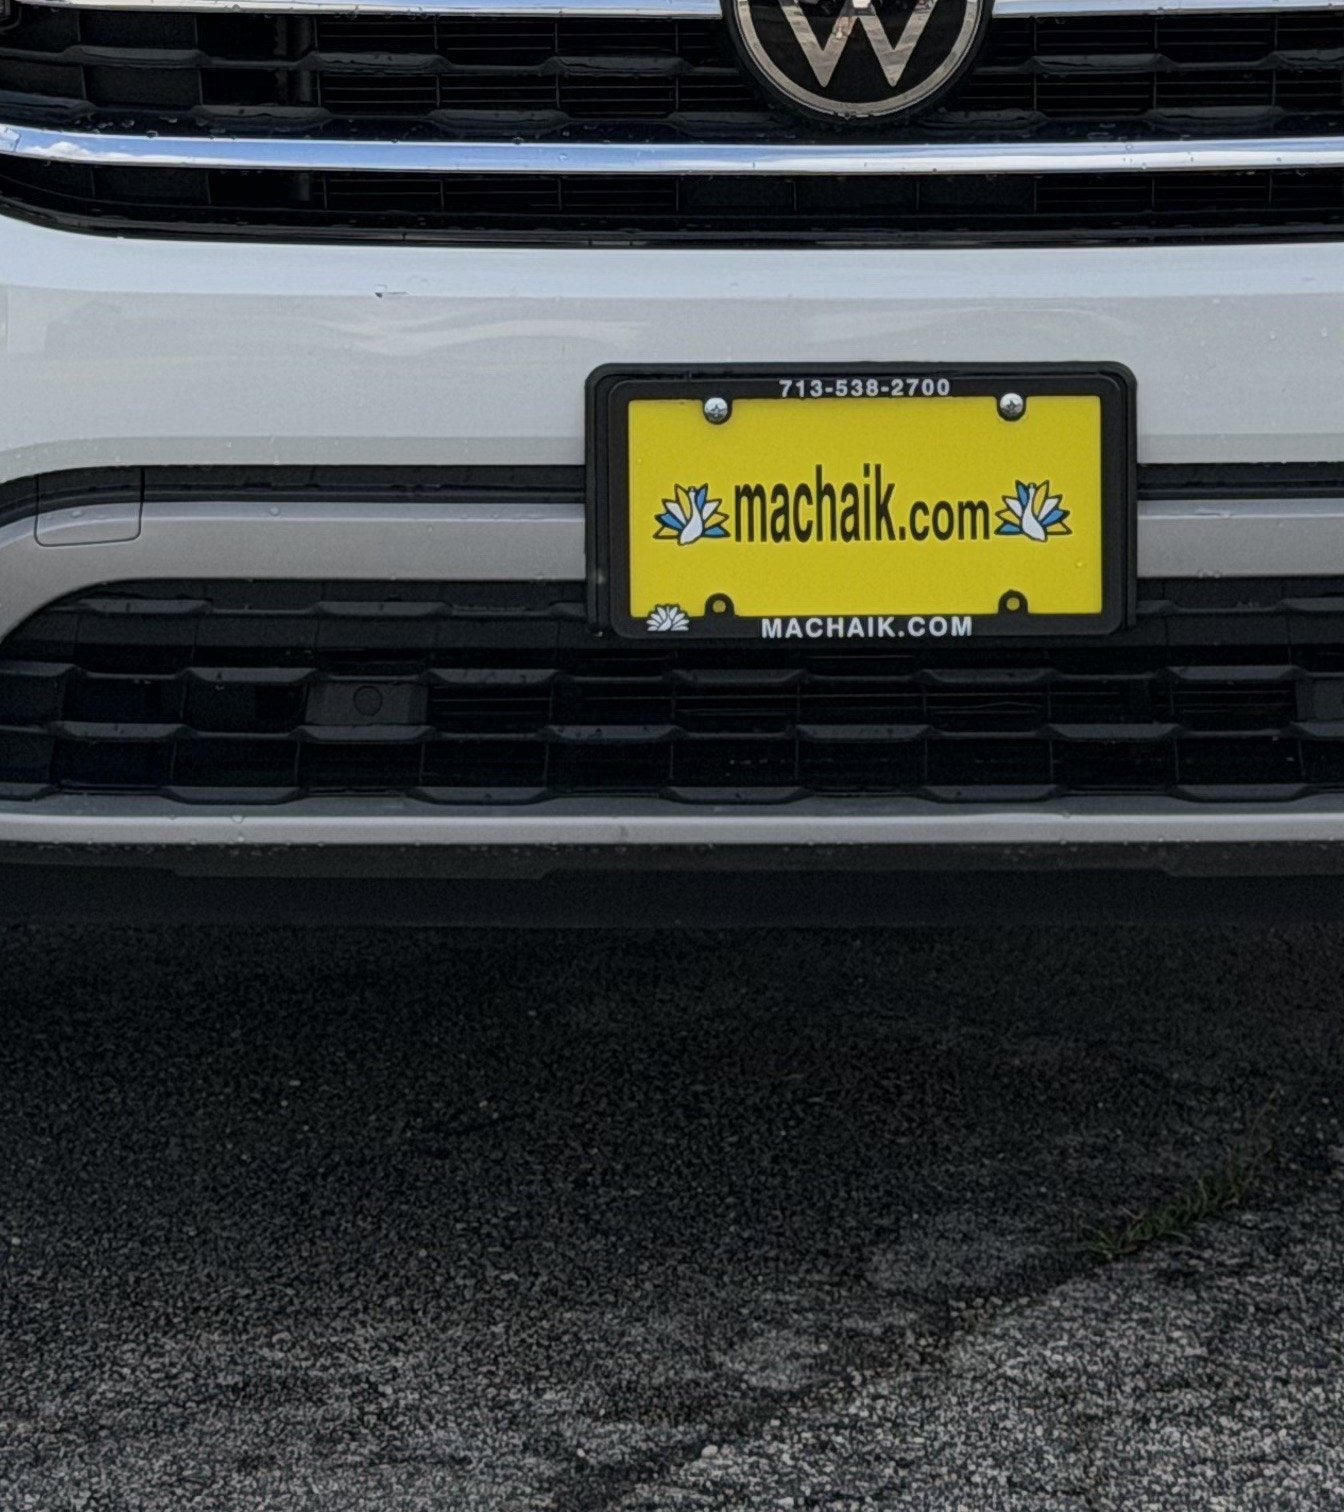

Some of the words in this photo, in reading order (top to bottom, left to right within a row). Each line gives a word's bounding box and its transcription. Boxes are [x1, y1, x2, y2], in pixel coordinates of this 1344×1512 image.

[779, 378, 951, 398] 713-538-2700
[734, 462, 990, 543] machaik.com
[761, 616, 973, 639] MACHAIK.COM
